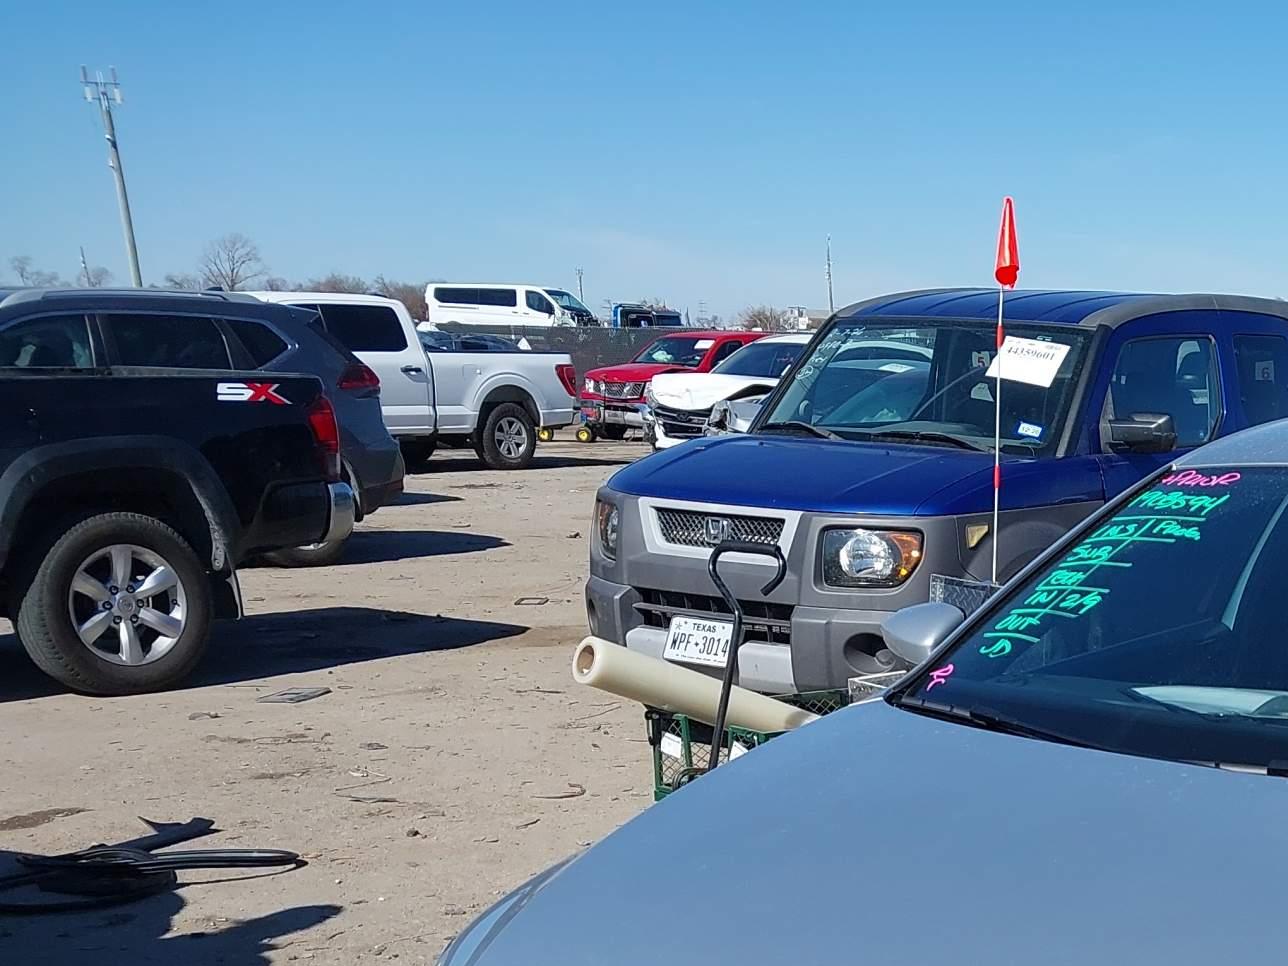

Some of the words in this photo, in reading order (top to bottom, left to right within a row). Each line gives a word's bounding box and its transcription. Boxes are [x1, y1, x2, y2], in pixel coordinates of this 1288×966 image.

[1261, 366, 1270, 378] 6
[692, 623, 717, 633] TEXAS
[995, 614, 1040, 630] OUT
